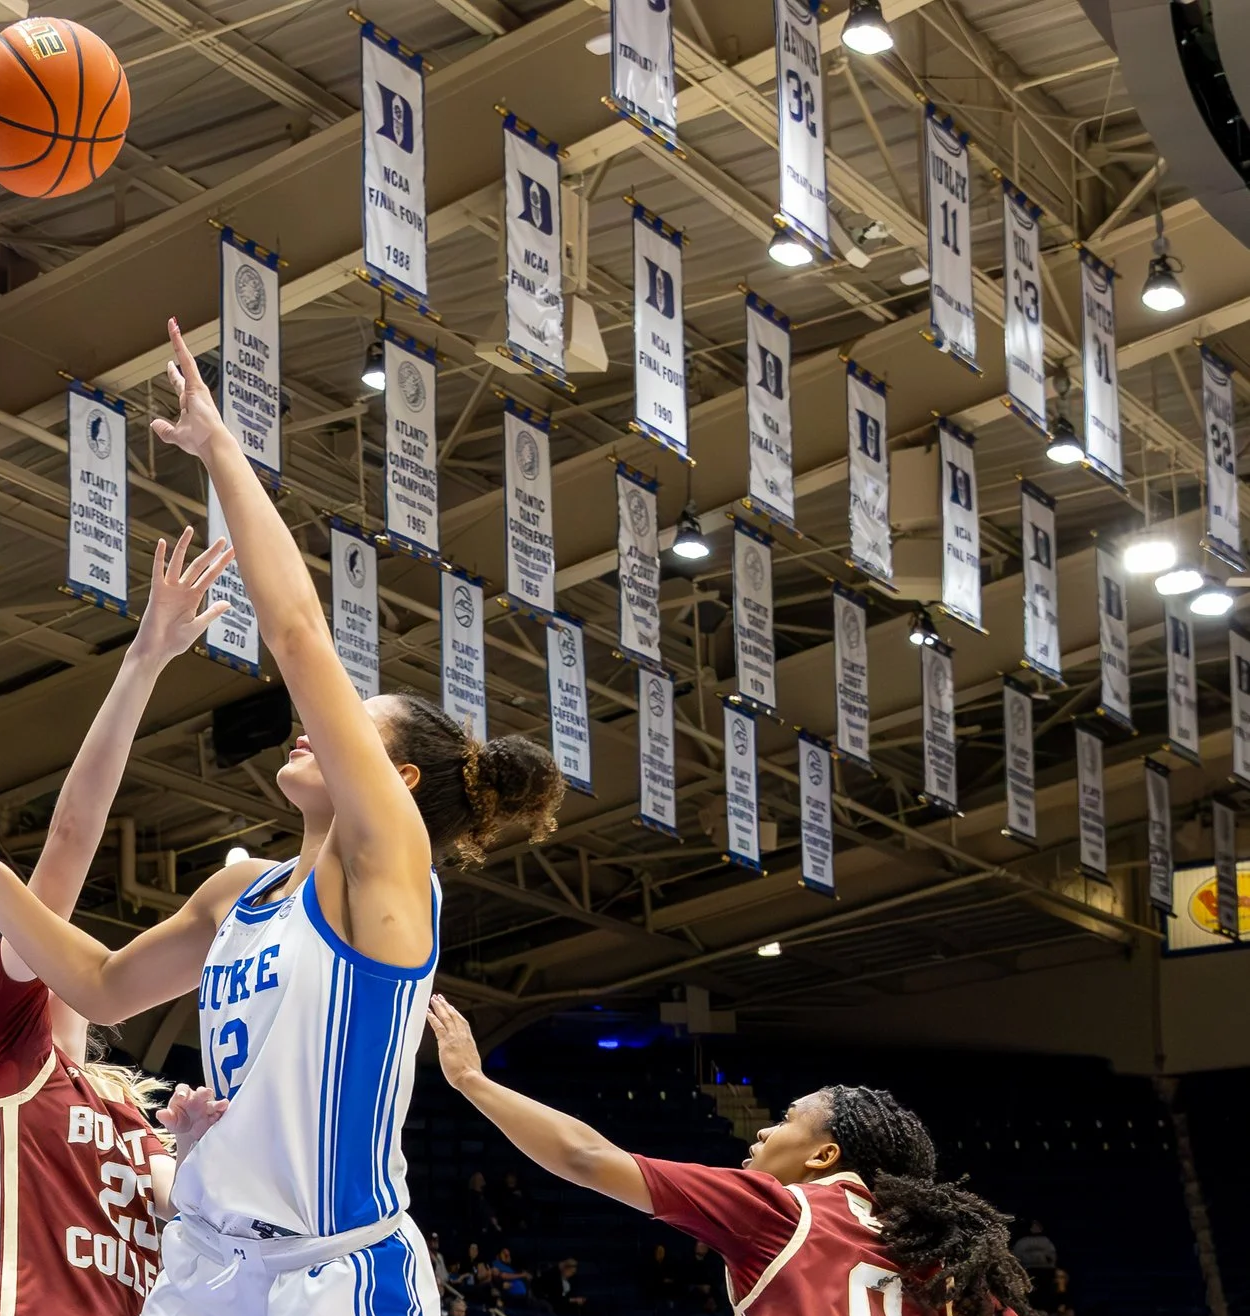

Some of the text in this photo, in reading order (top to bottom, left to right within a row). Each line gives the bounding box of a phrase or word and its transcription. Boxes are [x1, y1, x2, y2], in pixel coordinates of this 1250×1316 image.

[786, 68, 817, 138] 32
[383, 166, 410, 195] NCAA
[368, 187, 398, 217] FINAL
[940, 200, 961, 257] 11
[385, 245, 411, 271] 1988
[524, 249, 549, 276] NCAA
[234, 327, 269, 360] ATLANTIC
[651, 331, 671, 357] NCAA
[238, 349, 265, 375] COAST
[639, 351, 661, 376] FINAL
[226, 361, 278, 401] CONFERENCE
[228, 381, 276, 418] CHAMPIONS
[653, 402, 673, 424] 1990
[242, 429, 265, 453] 1964
[395, 420, 429, 447] ATLANTIC
[401, 440, 424, 462] COAST
[389, 451, 436, 486] CONFERENCE
[80, 470, 118, 497] ATLANTIC
[392, 470, 435, 502] CHAMPIONS
[88, 489, 112, 513] COAST
[71, 502, 124, 536] CONFERENCE
[74, 521, 123, 552] CHAMPIONS
[223, 629, 246, 649] 2010
[199, 944, 280, 1010] DUKE
